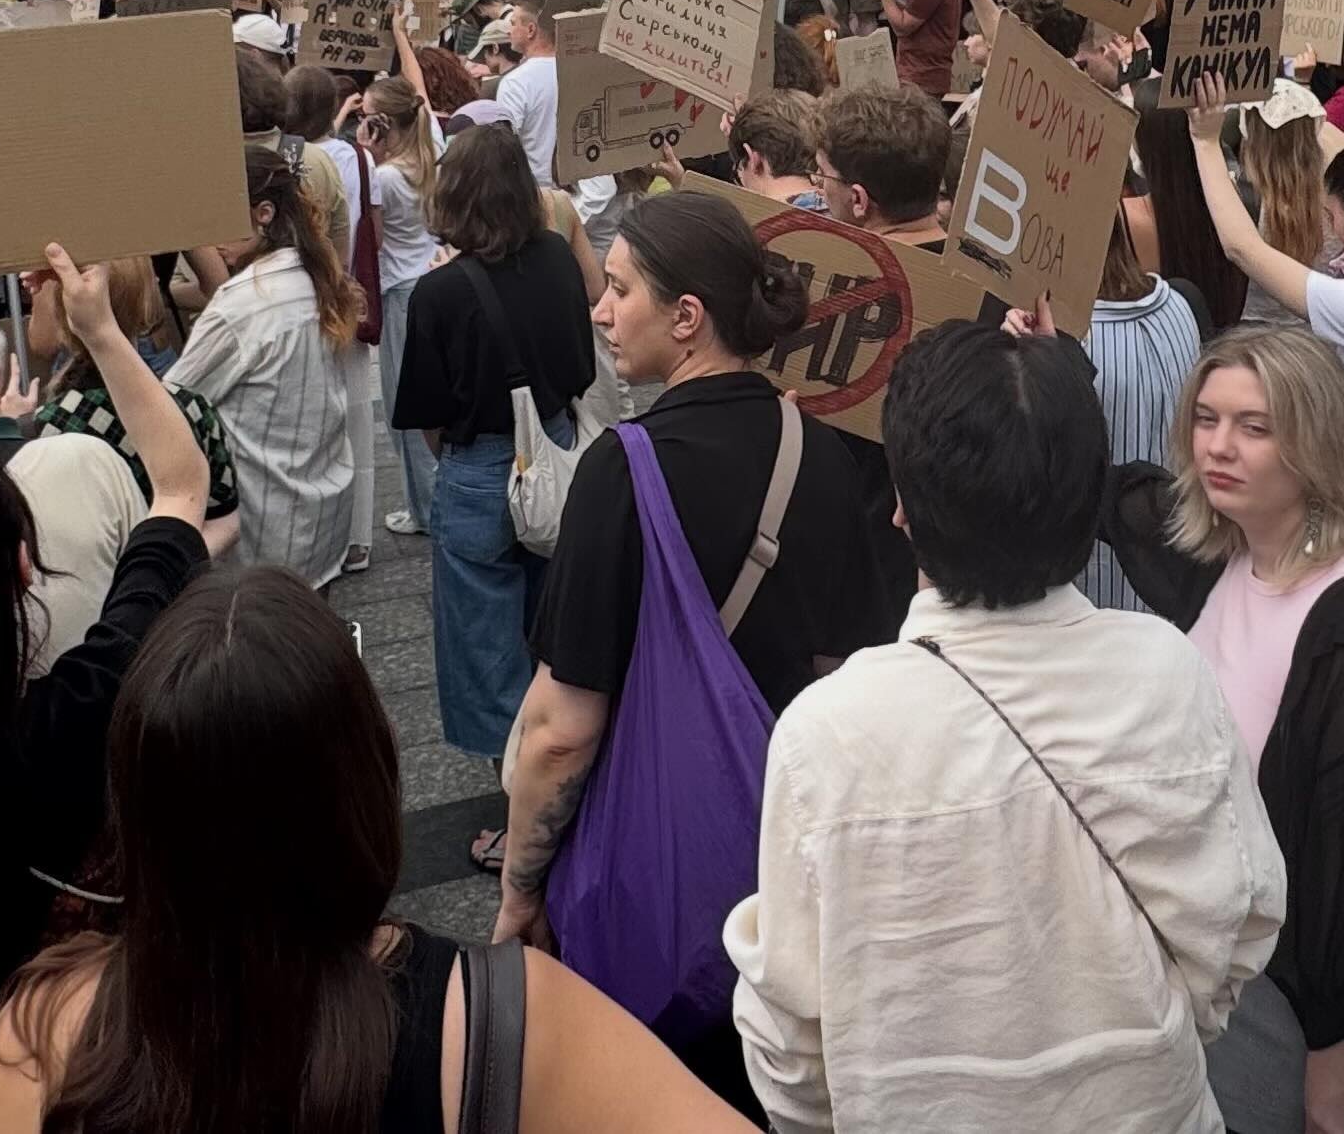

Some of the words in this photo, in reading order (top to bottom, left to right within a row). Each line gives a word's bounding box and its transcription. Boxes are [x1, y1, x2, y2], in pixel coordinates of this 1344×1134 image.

[616, 28, 634, 46] не
[619, 0, 723, 67] Сирському
[1201, 11, 1260, 47] НЕМА
[1285, 16, 1341, 40] РСЬКОГО!
[1170, 46, 1271, 98] КАНІКУЛ
